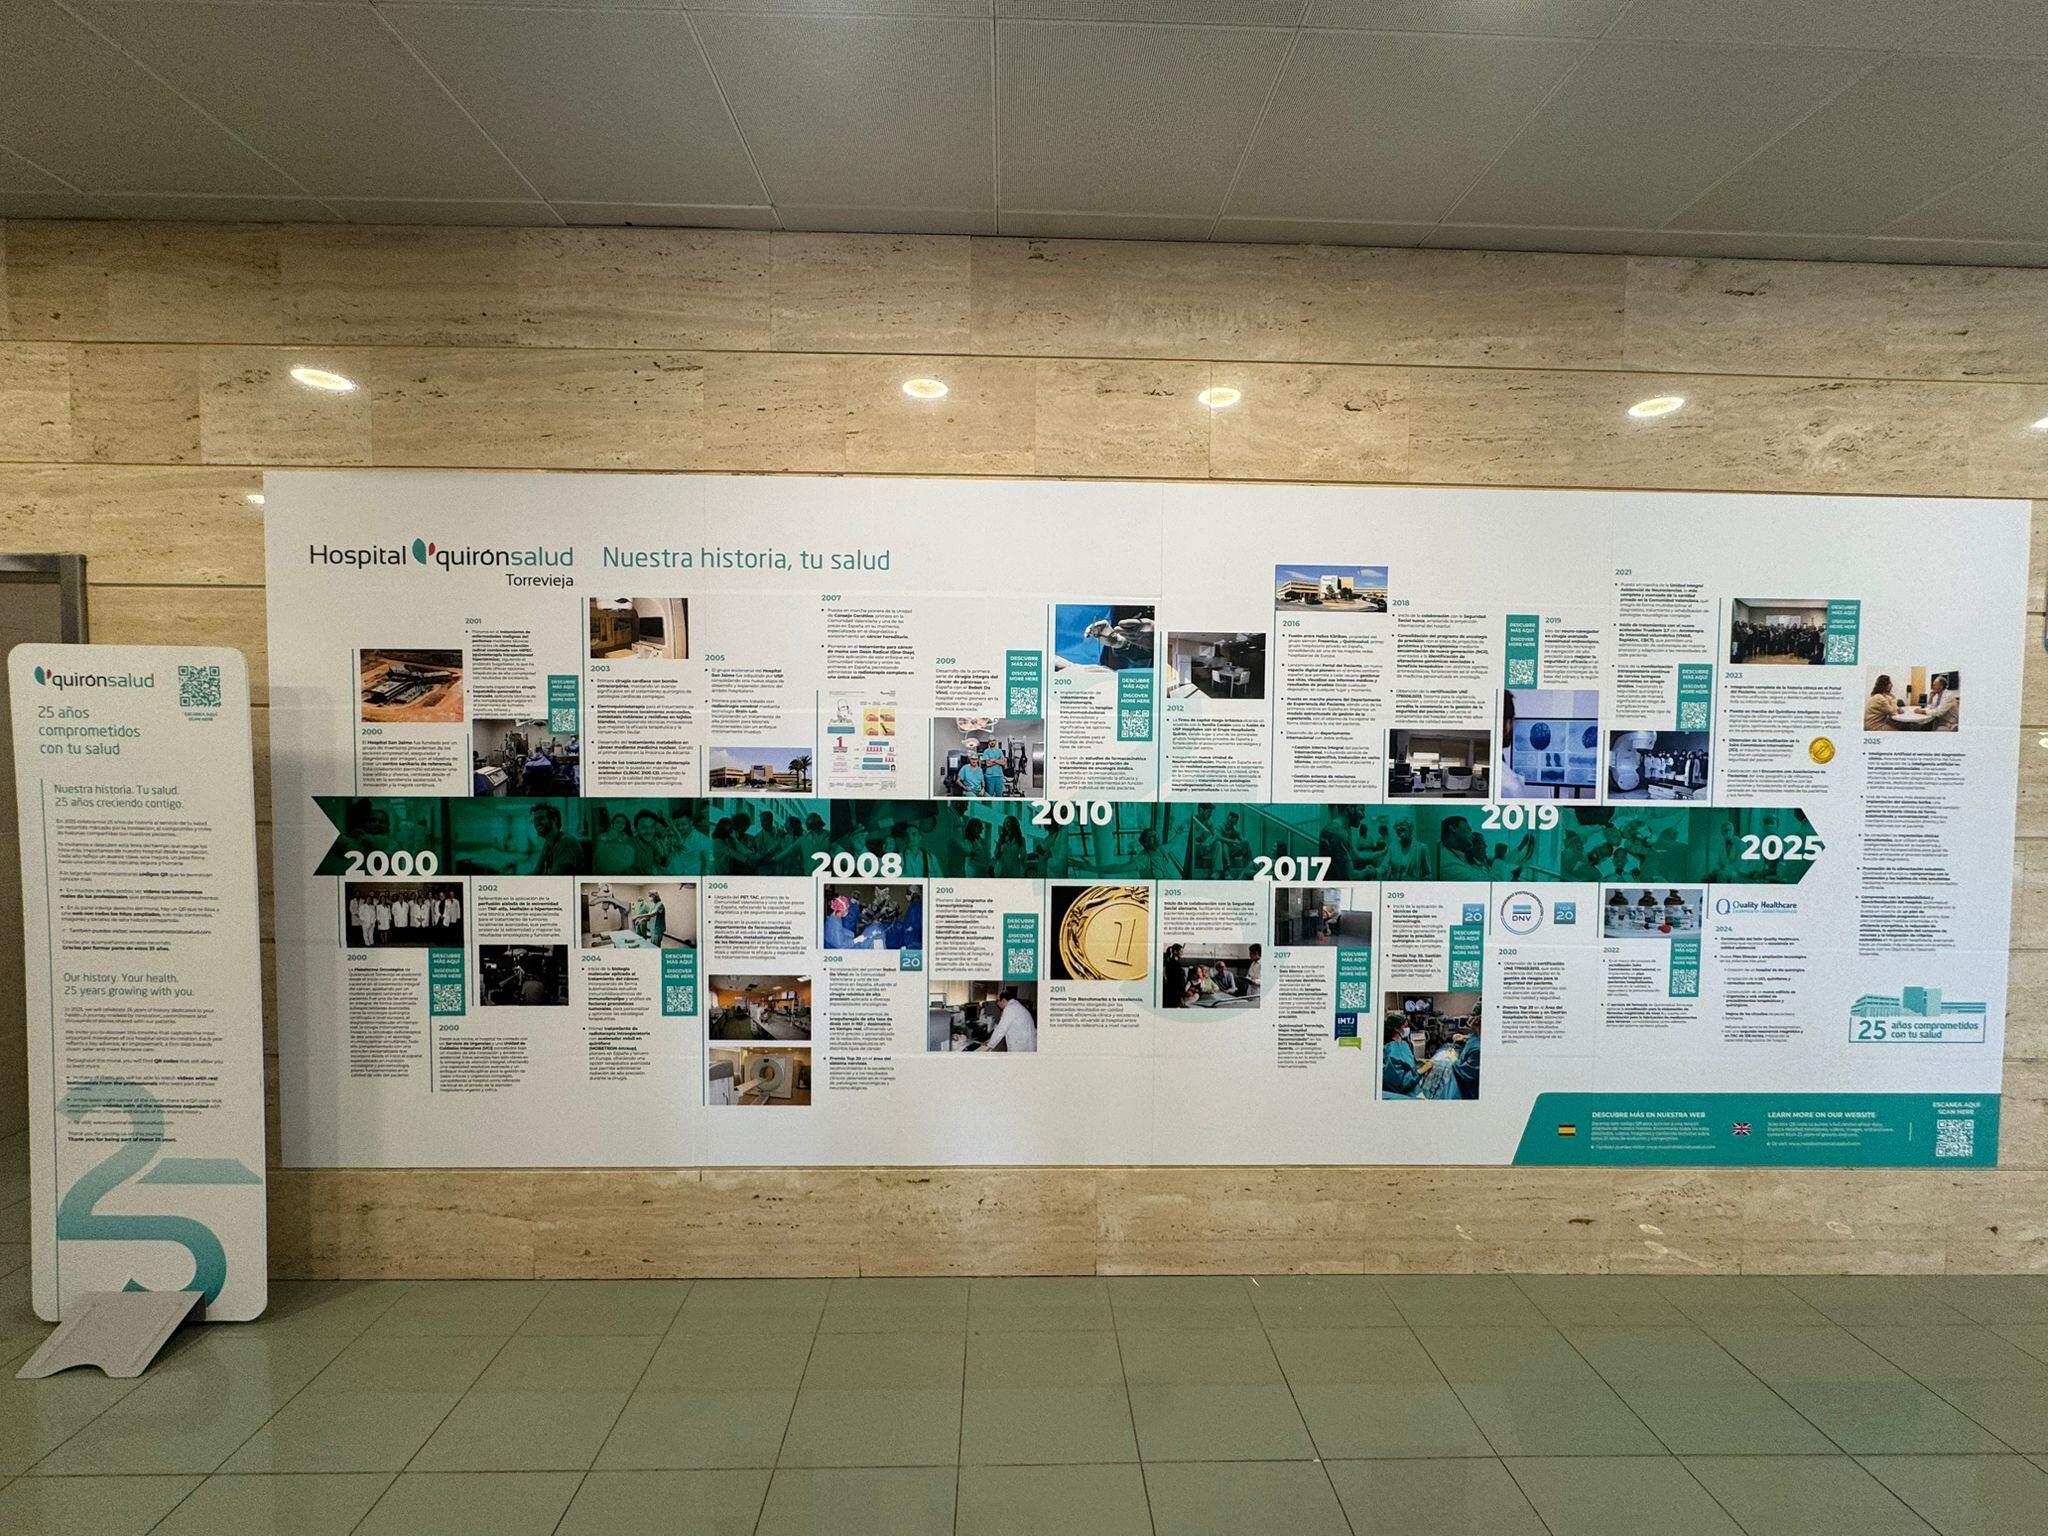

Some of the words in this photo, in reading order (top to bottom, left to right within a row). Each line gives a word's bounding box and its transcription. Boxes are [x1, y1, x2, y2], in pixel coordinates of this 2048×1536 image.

[310, 545, 406, 569] Hospital
[436, 546, 573, 572] quirónsalud
[604, 546, 692, 568] Nuestra
[702, 547, 792, 571] historia,
[800, 551, 822, 569] tu
[832, 550, 889, 570] salud
[506, 574, 573, 589] Torrevieja
[52, 673, 154, 691] quirónsalud
[38, 706, 54, 718] 25
[58, 706, 90, 718] años
[39, 725, 140, 739] comprometidos
[40, 744, 63, 754] con
[67, 744, 81, 754] tu
[85, 743, 120, 755] salud
[54, 784, 93, 794] Nuestra
[136, 785, 149, 794] Tu
[56, 797, 68, 806] 25
[71, 797, 94, 807] años
[96, 798, 143, 808] creciendo
[1032, 800, 1112, 825] 2010
[1482, 804, 1559, 830] 2019
[1742, 835, 1825, 860] 2025
[344, 851, 438, 877] 2000
[811, 852, 902, 878] 2008
[1253, 856, 1332, 882] 2017
[1733, 901, 1758, 910] Quality
[1465, 913, 1482, 921] 20
[1556, 912, 1573, 920] 20
[903, 958, 920, 966] 20
[64, 972, 80, 982] Our
[122, 974, 143, 982] Your
[64, 986, 77, 995] 25
[80, 988, 106, 997] years
[108, 986, 148, 998] growing
[150, 987, 172, 996] with
[1858, 1020, 1886, 1039] 25
[1914, 1022, 1978, 1030] comprometidos
